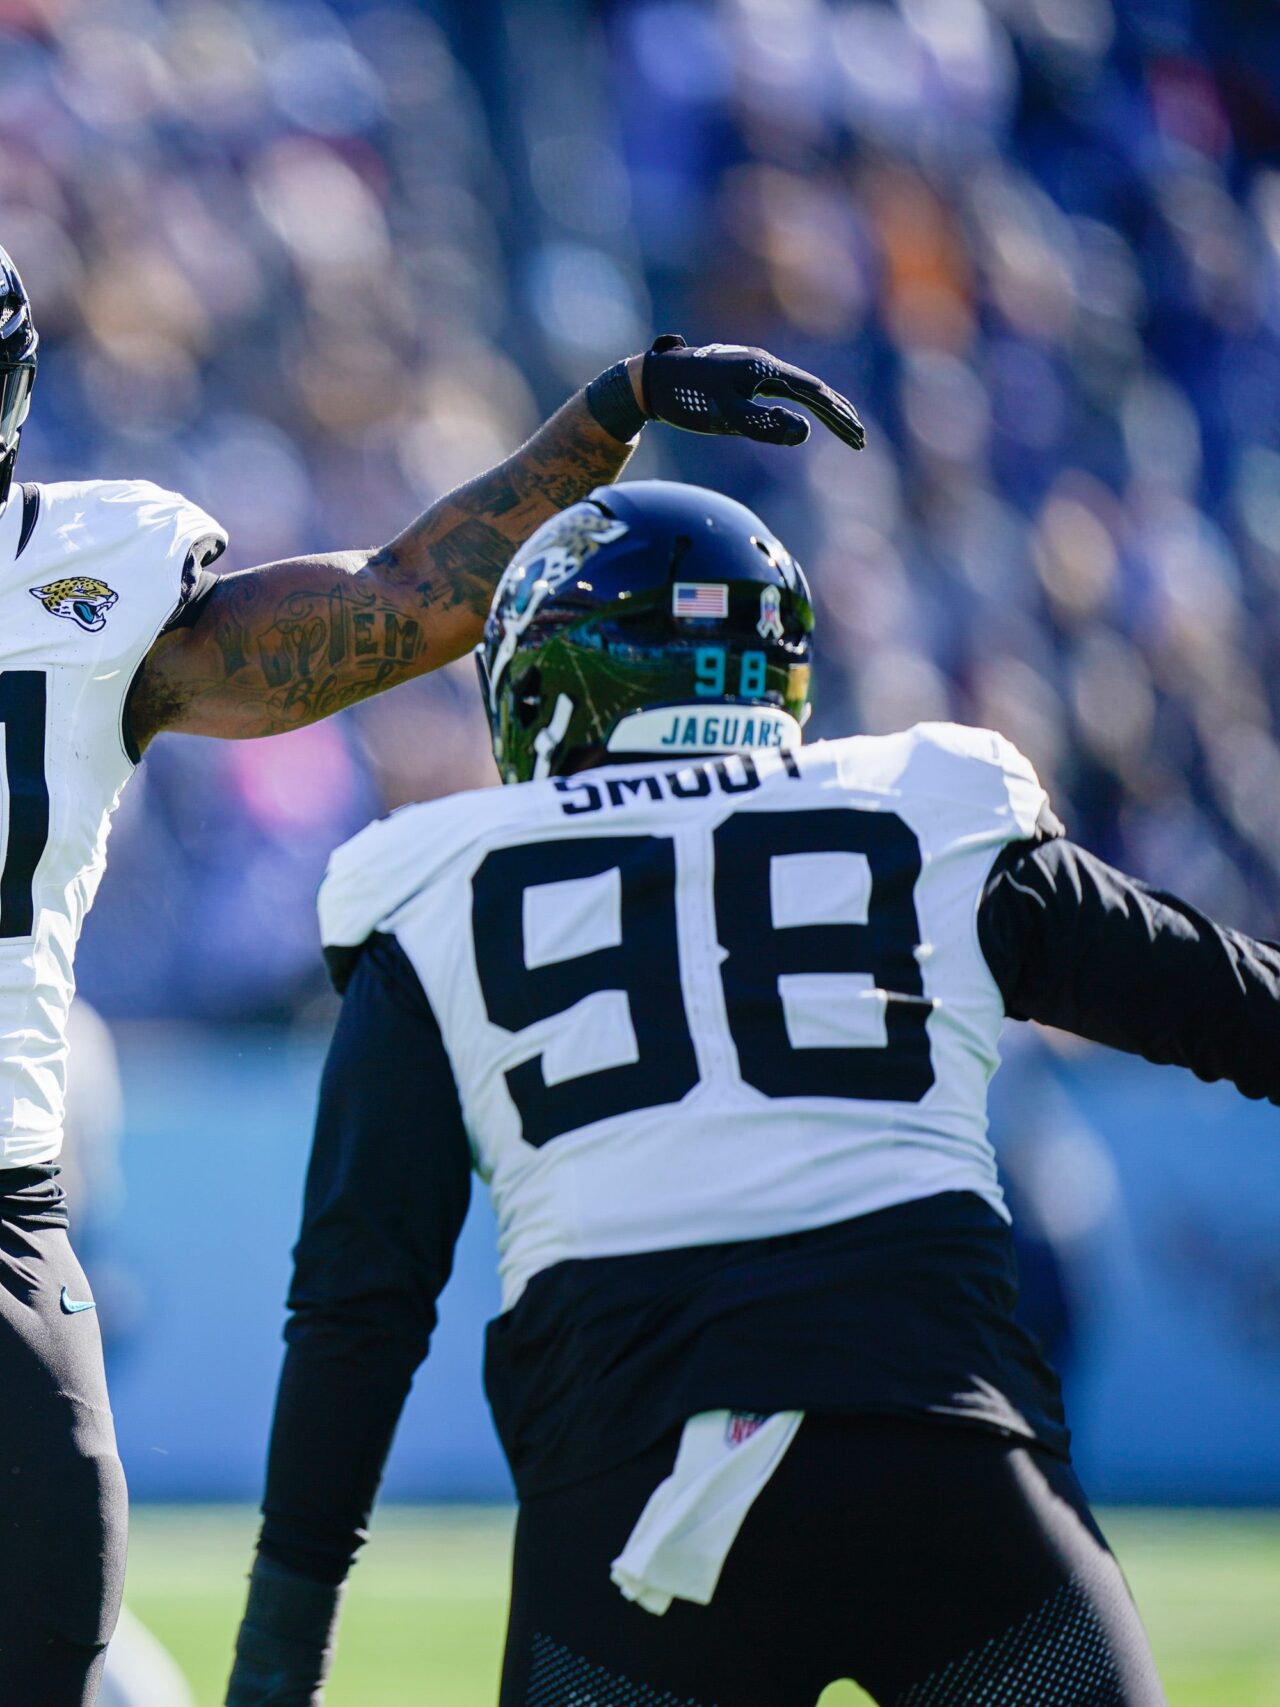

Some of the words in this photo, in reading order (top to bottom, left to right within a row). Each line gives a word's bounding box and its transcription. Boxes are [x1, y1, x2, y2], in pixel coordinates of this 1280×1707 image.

[694, 647, 767, 698] 98
[661, 716, 785, 748] JAGUARS
[471, 808, 937, 1150] 98
